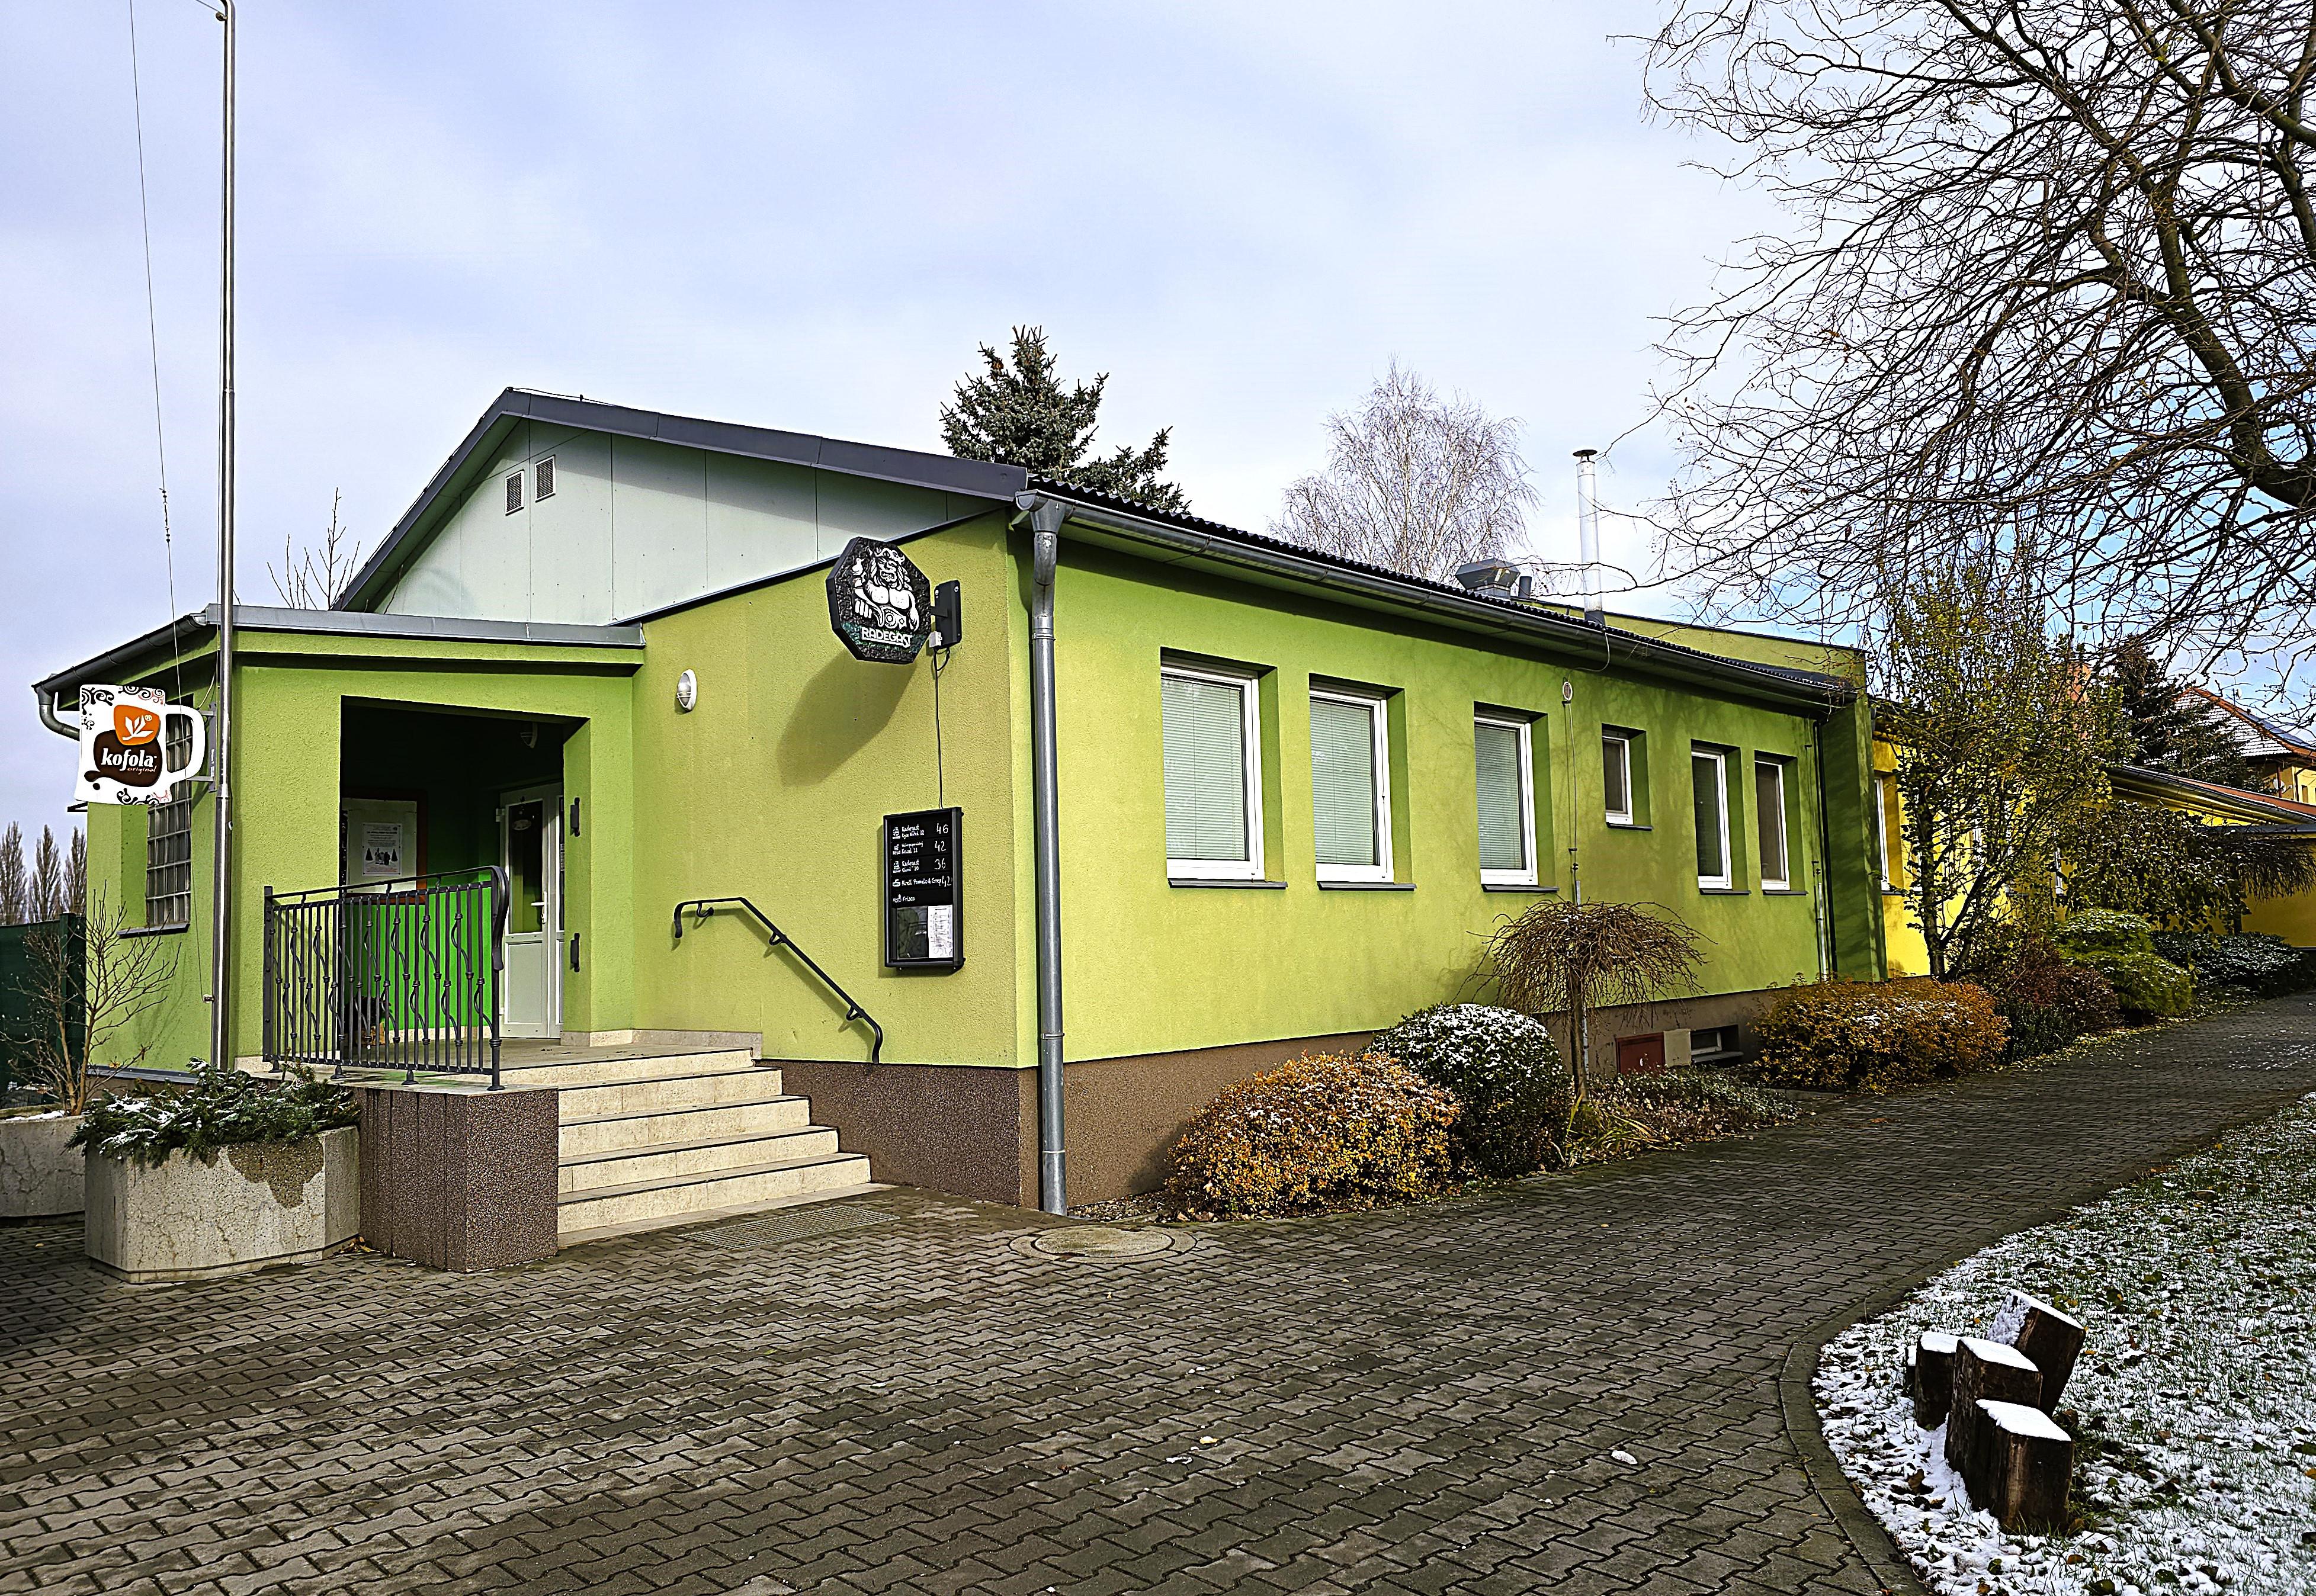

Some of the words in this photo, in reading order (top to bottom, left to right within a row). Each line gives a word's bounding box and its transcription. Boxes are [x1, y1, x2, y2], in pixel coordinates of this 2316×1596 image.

[861, 627, 913, 647] RADEGAST
[101, 747, 153, 771] kofola
[127, 765, 156, 775] original
[902, 824, 919, 832] Radegast
[936, 823, 948, 834] 46
[934, 840, 947, 852] 42
[902, 859, 919, 868] Radegast
[934, 858, 946, 870] 36
